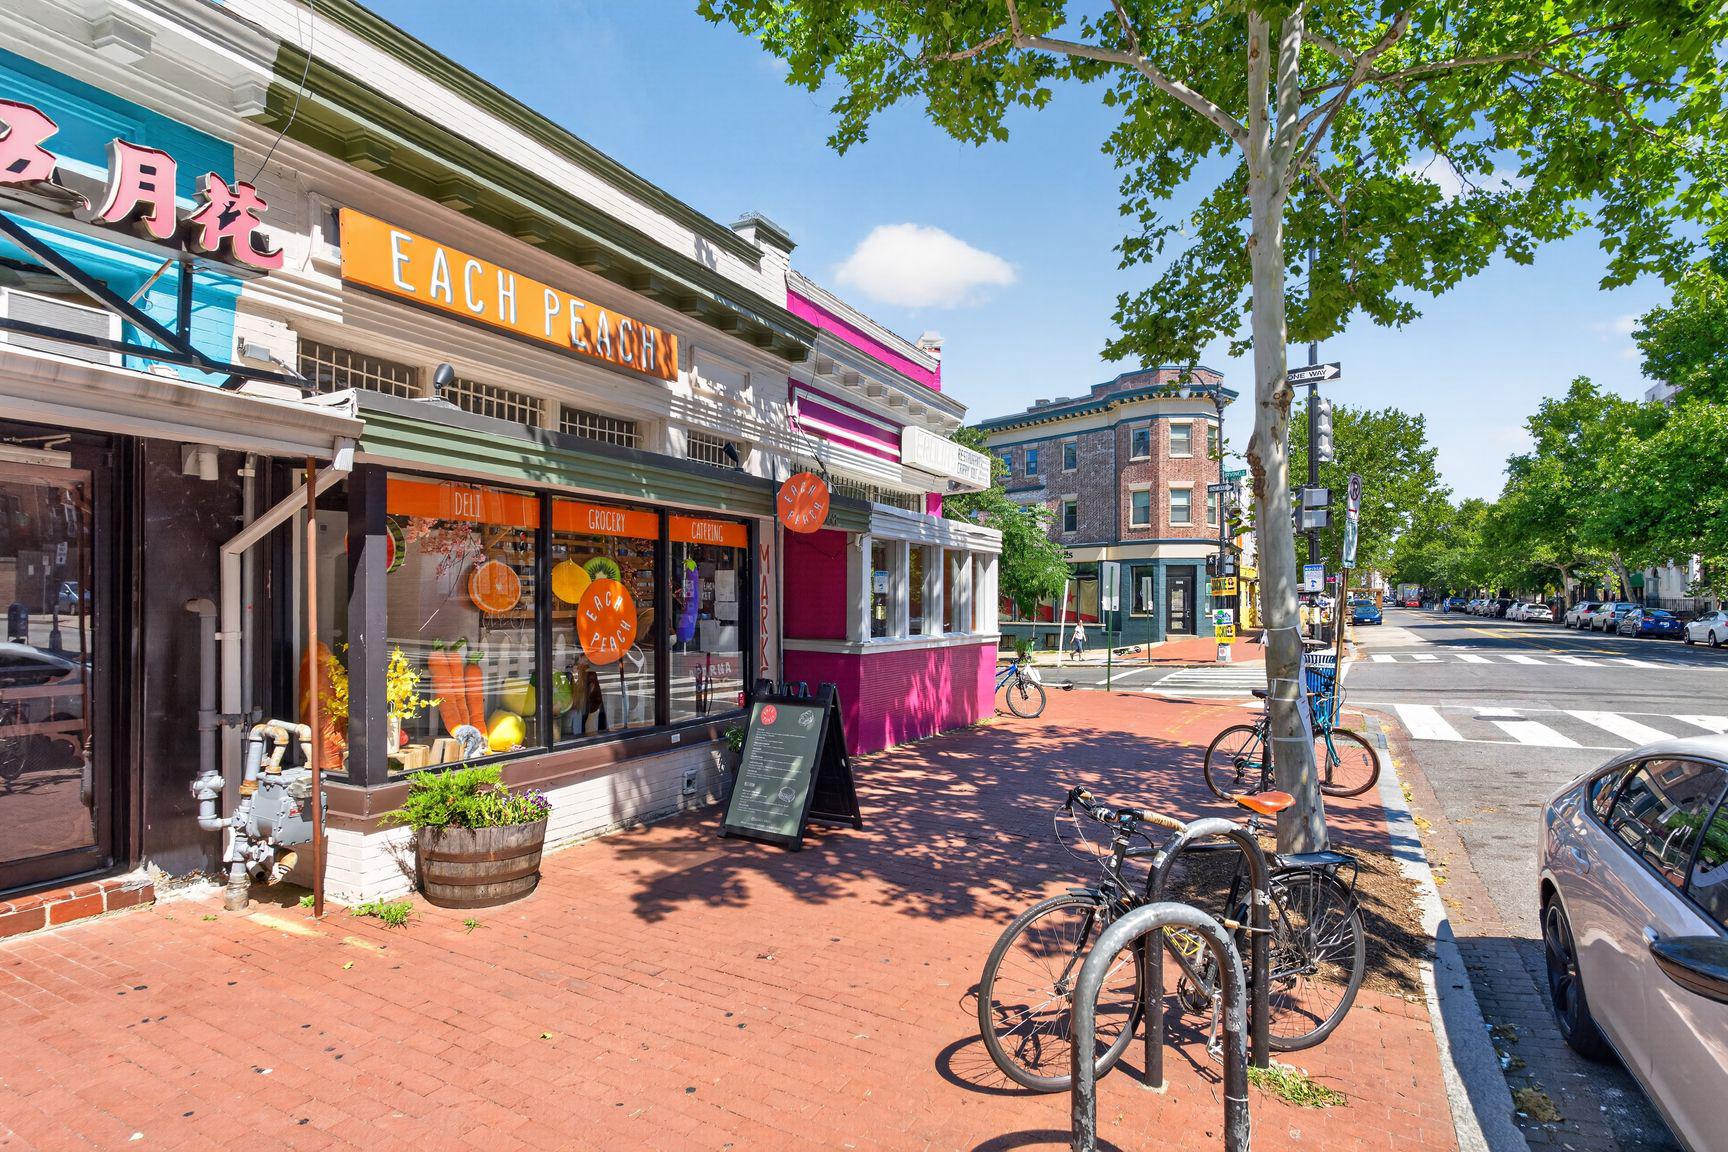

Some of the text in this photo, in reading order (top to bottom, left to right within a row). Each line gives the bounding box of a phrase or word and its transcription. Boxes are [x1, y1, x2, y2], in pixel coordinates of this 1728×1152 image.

[389, 229, 656, 371] EACH PEACH
[1287, 369, 1327, 381] ONE WAY
[454, 492, 481, 518] DELI
[783, 480, 817, 504] EACH
[588, 508, 626, 533] GROCERY
[787, 501, 825, 527] PEACH
[691, 523, 724, 543] CATERING
[585, 591, 623, 622] EACH
[590, 619, 632, 653] PEACH
